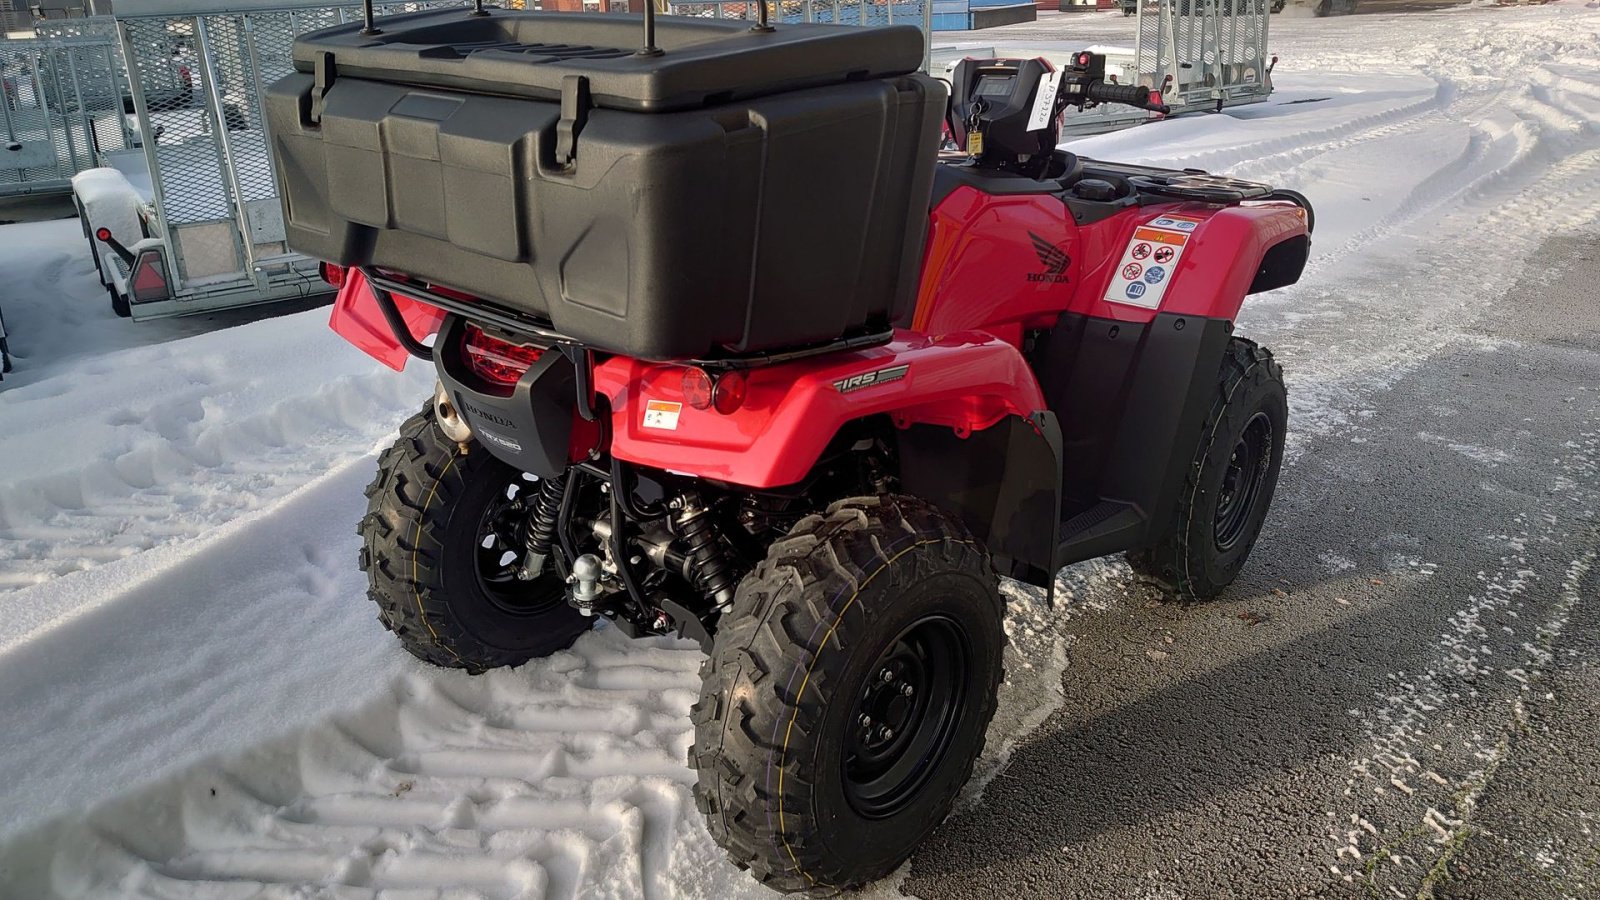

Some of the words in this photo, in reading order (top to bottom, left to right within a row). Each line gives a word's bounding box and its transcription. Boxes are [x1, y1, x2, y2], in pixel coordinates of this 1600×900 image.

[1026, 272, 1070, 284] HONDA
[842, 371, 878, 390] IRS
[465, 402, 519, 430] HONDA
